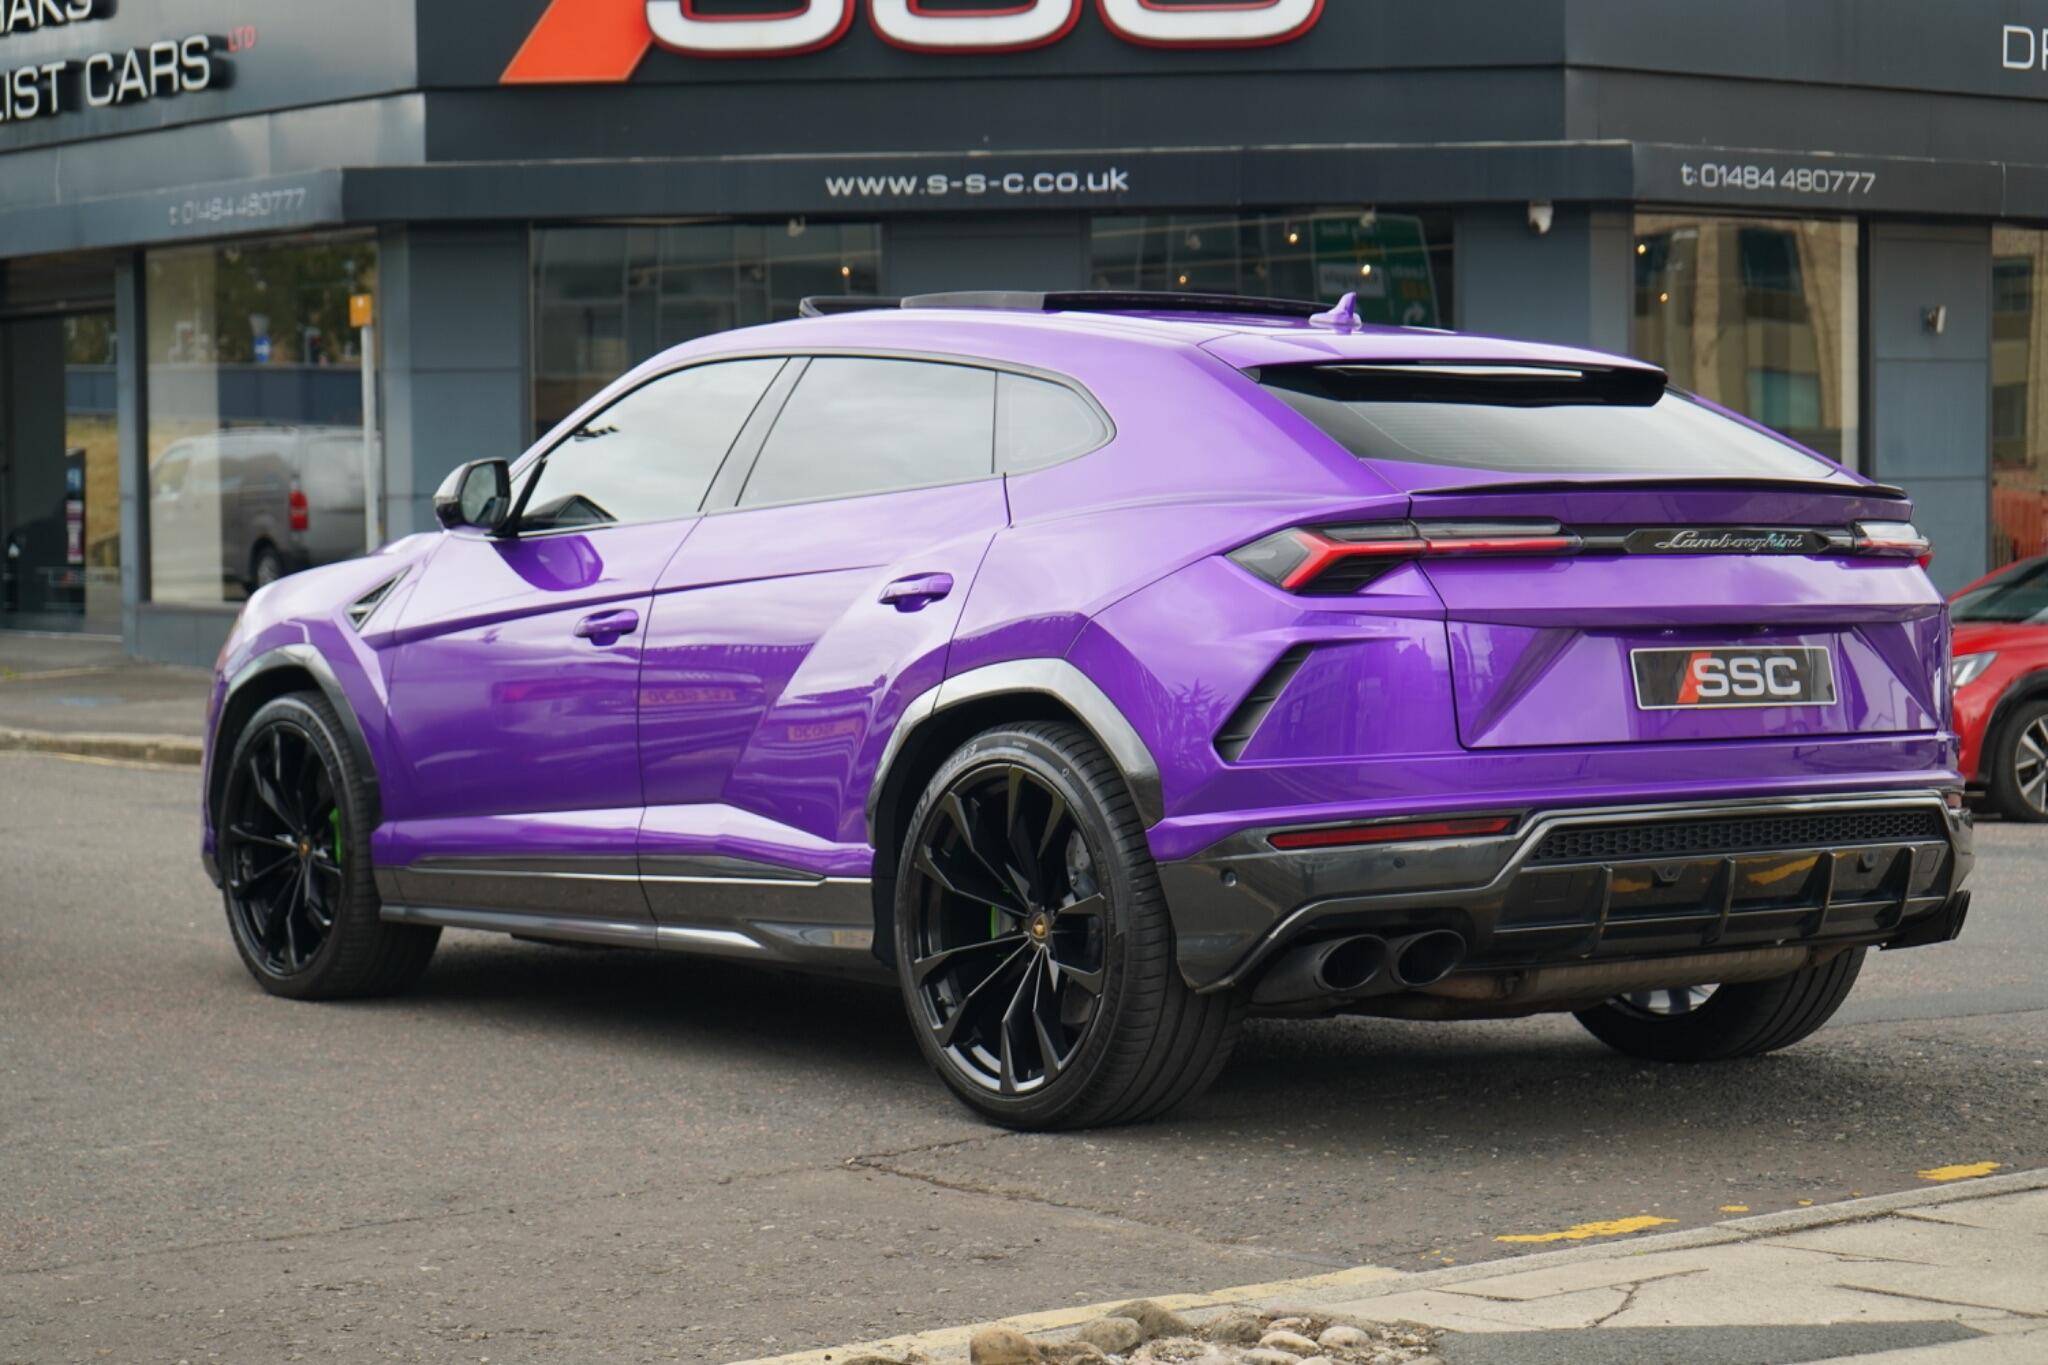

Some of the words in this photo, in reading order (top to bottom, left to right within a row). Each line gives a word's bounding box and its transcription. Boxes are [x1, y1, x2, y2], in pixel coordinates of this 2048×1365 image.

[0, 62, 67, 121] IST
[85, 34, 210, 107] CARS
[227, 26, 257, 53] LTD
[825, 167, 1129, 196] www.s-s-c.co.uk
[1654, 530, 1803, 552] Lamborghini
[1693, 656, 1800, 697] SSC
